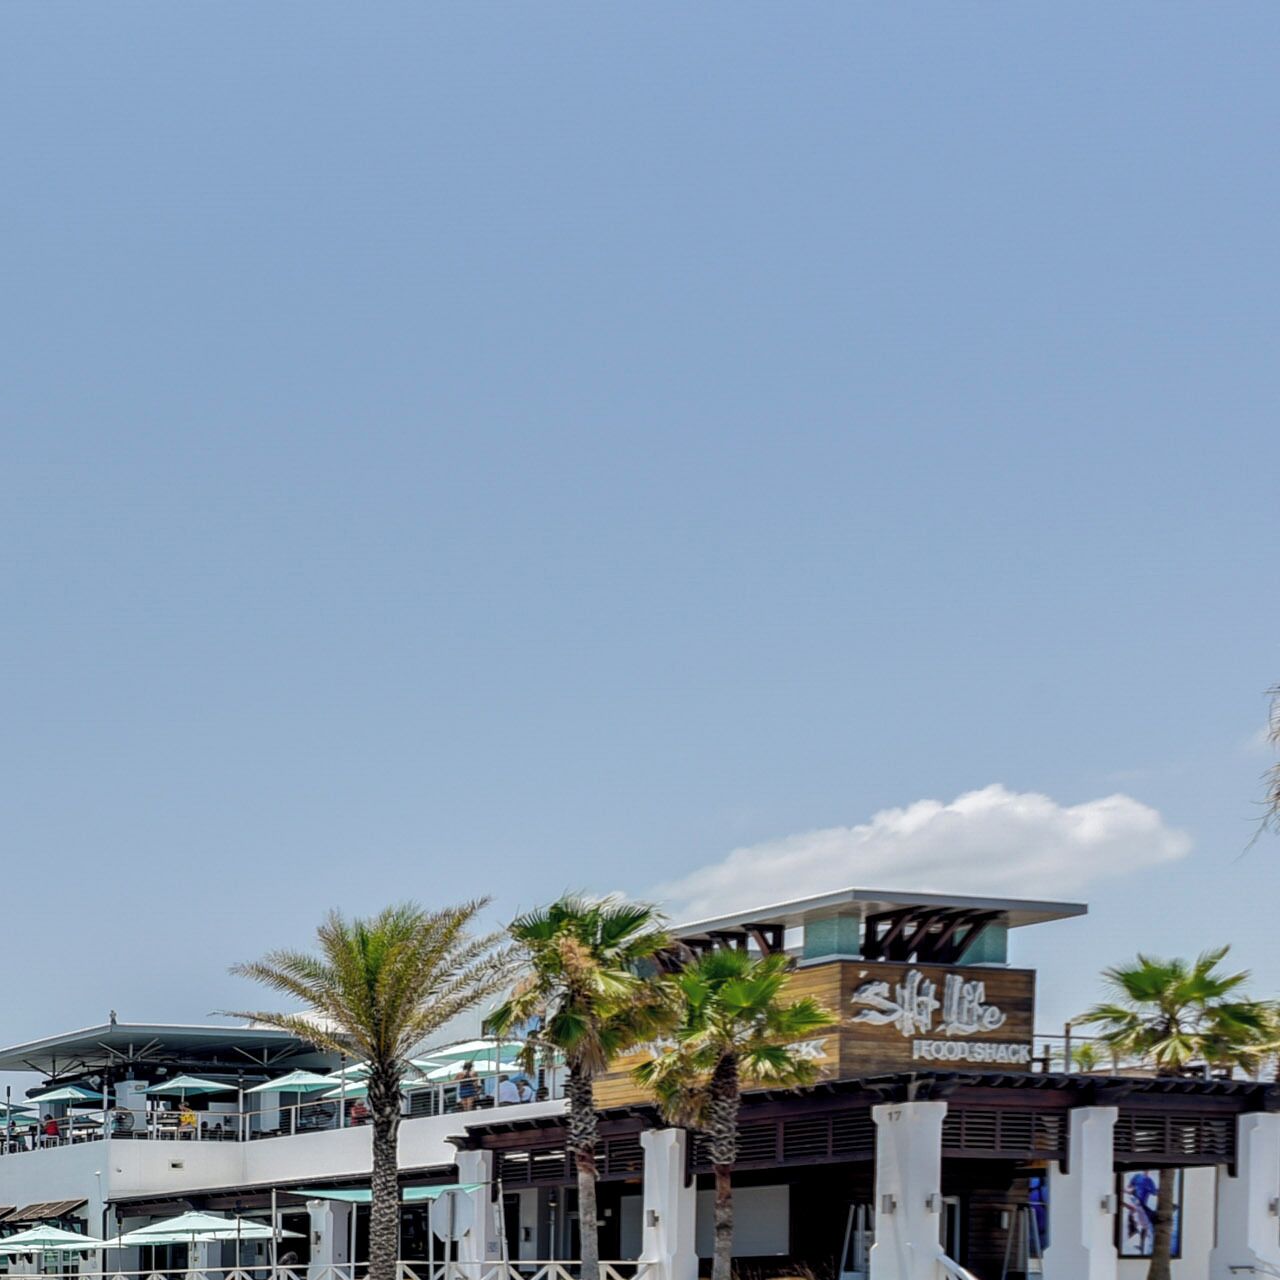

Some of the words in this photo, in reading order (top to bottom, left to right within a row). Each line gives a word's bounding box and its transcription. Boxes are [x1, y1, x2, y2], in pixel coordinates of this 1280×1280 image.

[936, 974, 1007, 1036] Life
[913, 1040, 969, 1061] FOOD
[973, 1042, 1031, 1064] SHACK
[887, 1110, 902, 1122] 17
